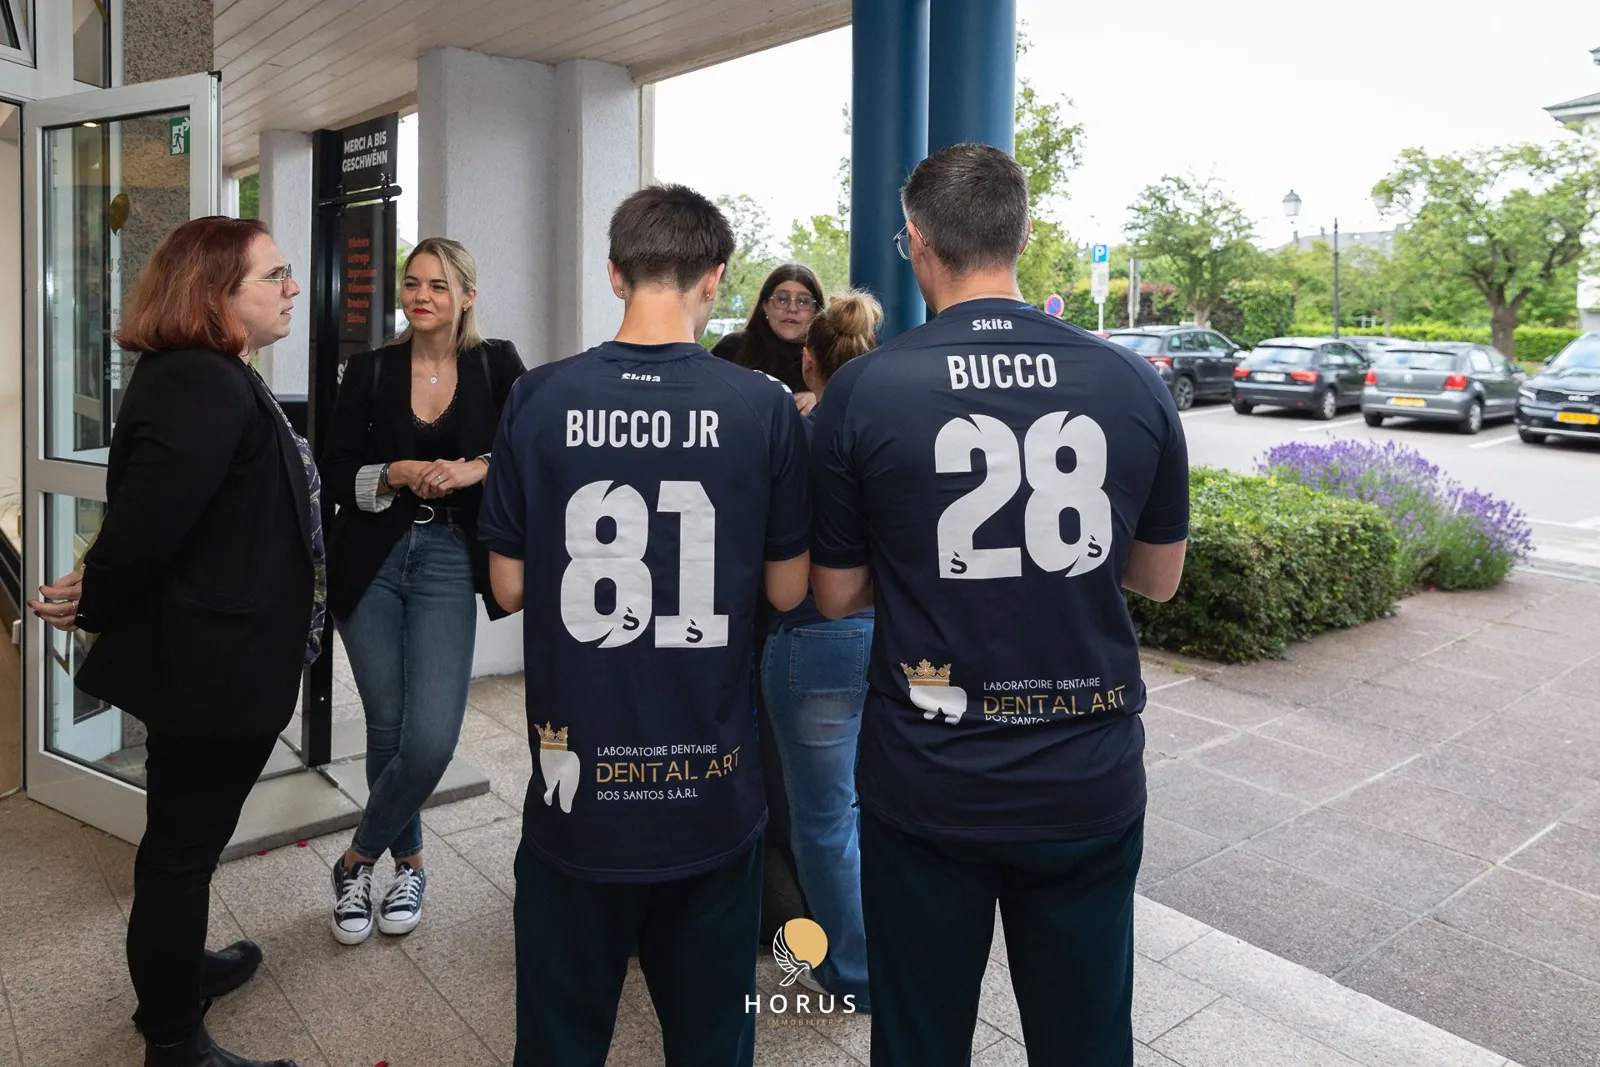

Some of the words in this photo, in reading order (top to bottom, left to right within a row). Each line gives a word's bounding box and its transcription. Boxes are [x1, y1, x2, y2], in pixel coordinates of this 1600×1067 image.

[343, 136, 366, 154] MERCI
[366, 134, 374, 149] A
[374, 130, 387, 147] BIS
[341, 149, 388, 173] GESCHWËNN
[972, 319, 1013, 331] Skita
[947, 353, 1057, 390] BUCCO
[566, 409, 671, 449] BUCCO
[682, 410, 720, 449] JR
[934, 411, 1113, 580] 28
[560, 480, 729, 649] 81
[983, 679, 1053, 691] LABORATOIRE
[1056, 677, 1101, 690] DENTAIRE
[983, 694, 1085, 715] DENTAL
[1091, 684, 1126, 713] ART
[1010, 715, 1051, 726] SANTO
[597, 746, 668, 757] LABORATOIRE
[671, 744, 718, 755] DENTAIRE
[596, 760, 698, 783] DENTAL
[705, 746, 741, 779] ART
[597, 790, 620, 801] DOS
[622, 789, 665, 800] SANTOS
